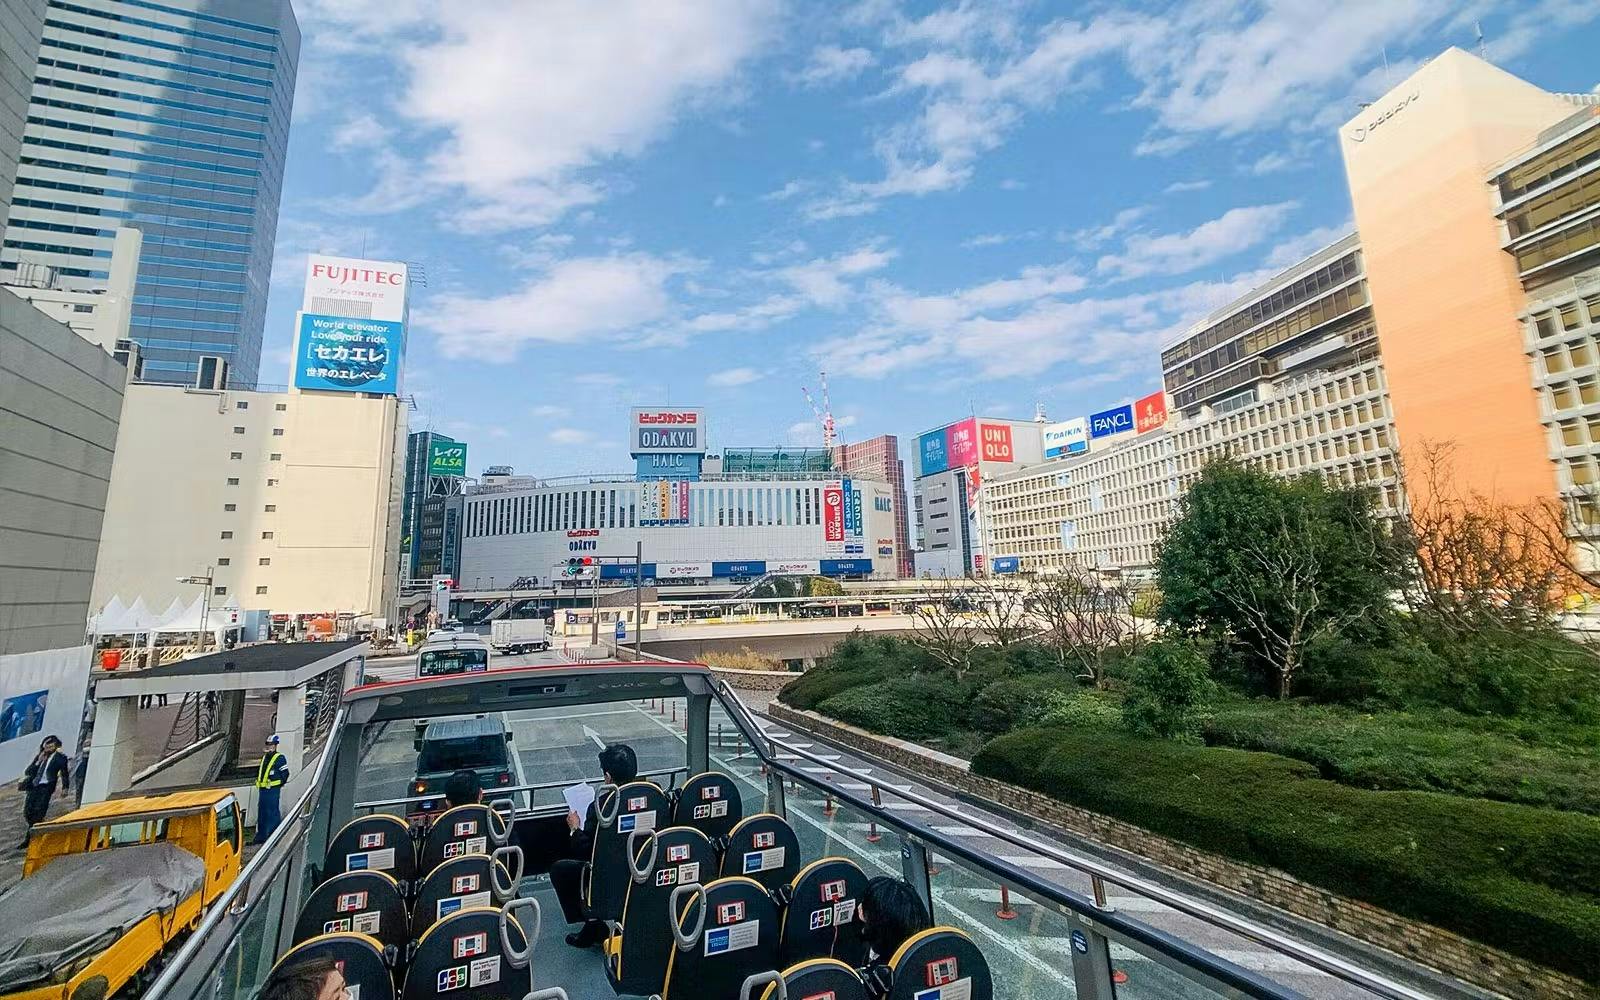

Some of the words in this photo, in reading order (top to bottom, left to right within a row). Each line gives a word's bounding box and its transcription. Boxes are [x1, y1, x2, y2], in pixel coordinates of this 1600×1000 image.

[312, 263, 403, 286] FUJITEC
[313, 319, 345, 330] World
[347, 321, 390, 334] elevator.
[311, 331, 335, 341] Love
[340, 331, 364, 344] your
[366, 333, 389, 345] ride.
[639, 413, 697, 424] ビックカメラ
[1094, 412, 1131, 432] FANCL
[642, 430, 694, 447] ODAKYU
[984, 429, 1007, 443] UNI
[1053, 428, 1083, 440] DAIKIN
[434, 447, 463, 458] レイク
[985, 444, 1009, 458] QLO
[433, 457, 463, 467] ALSA
[652, 454, 684, 467] HALC
[874, 497, 892, 512] HALC
[569, 540, 597, 551] ODAKYU
